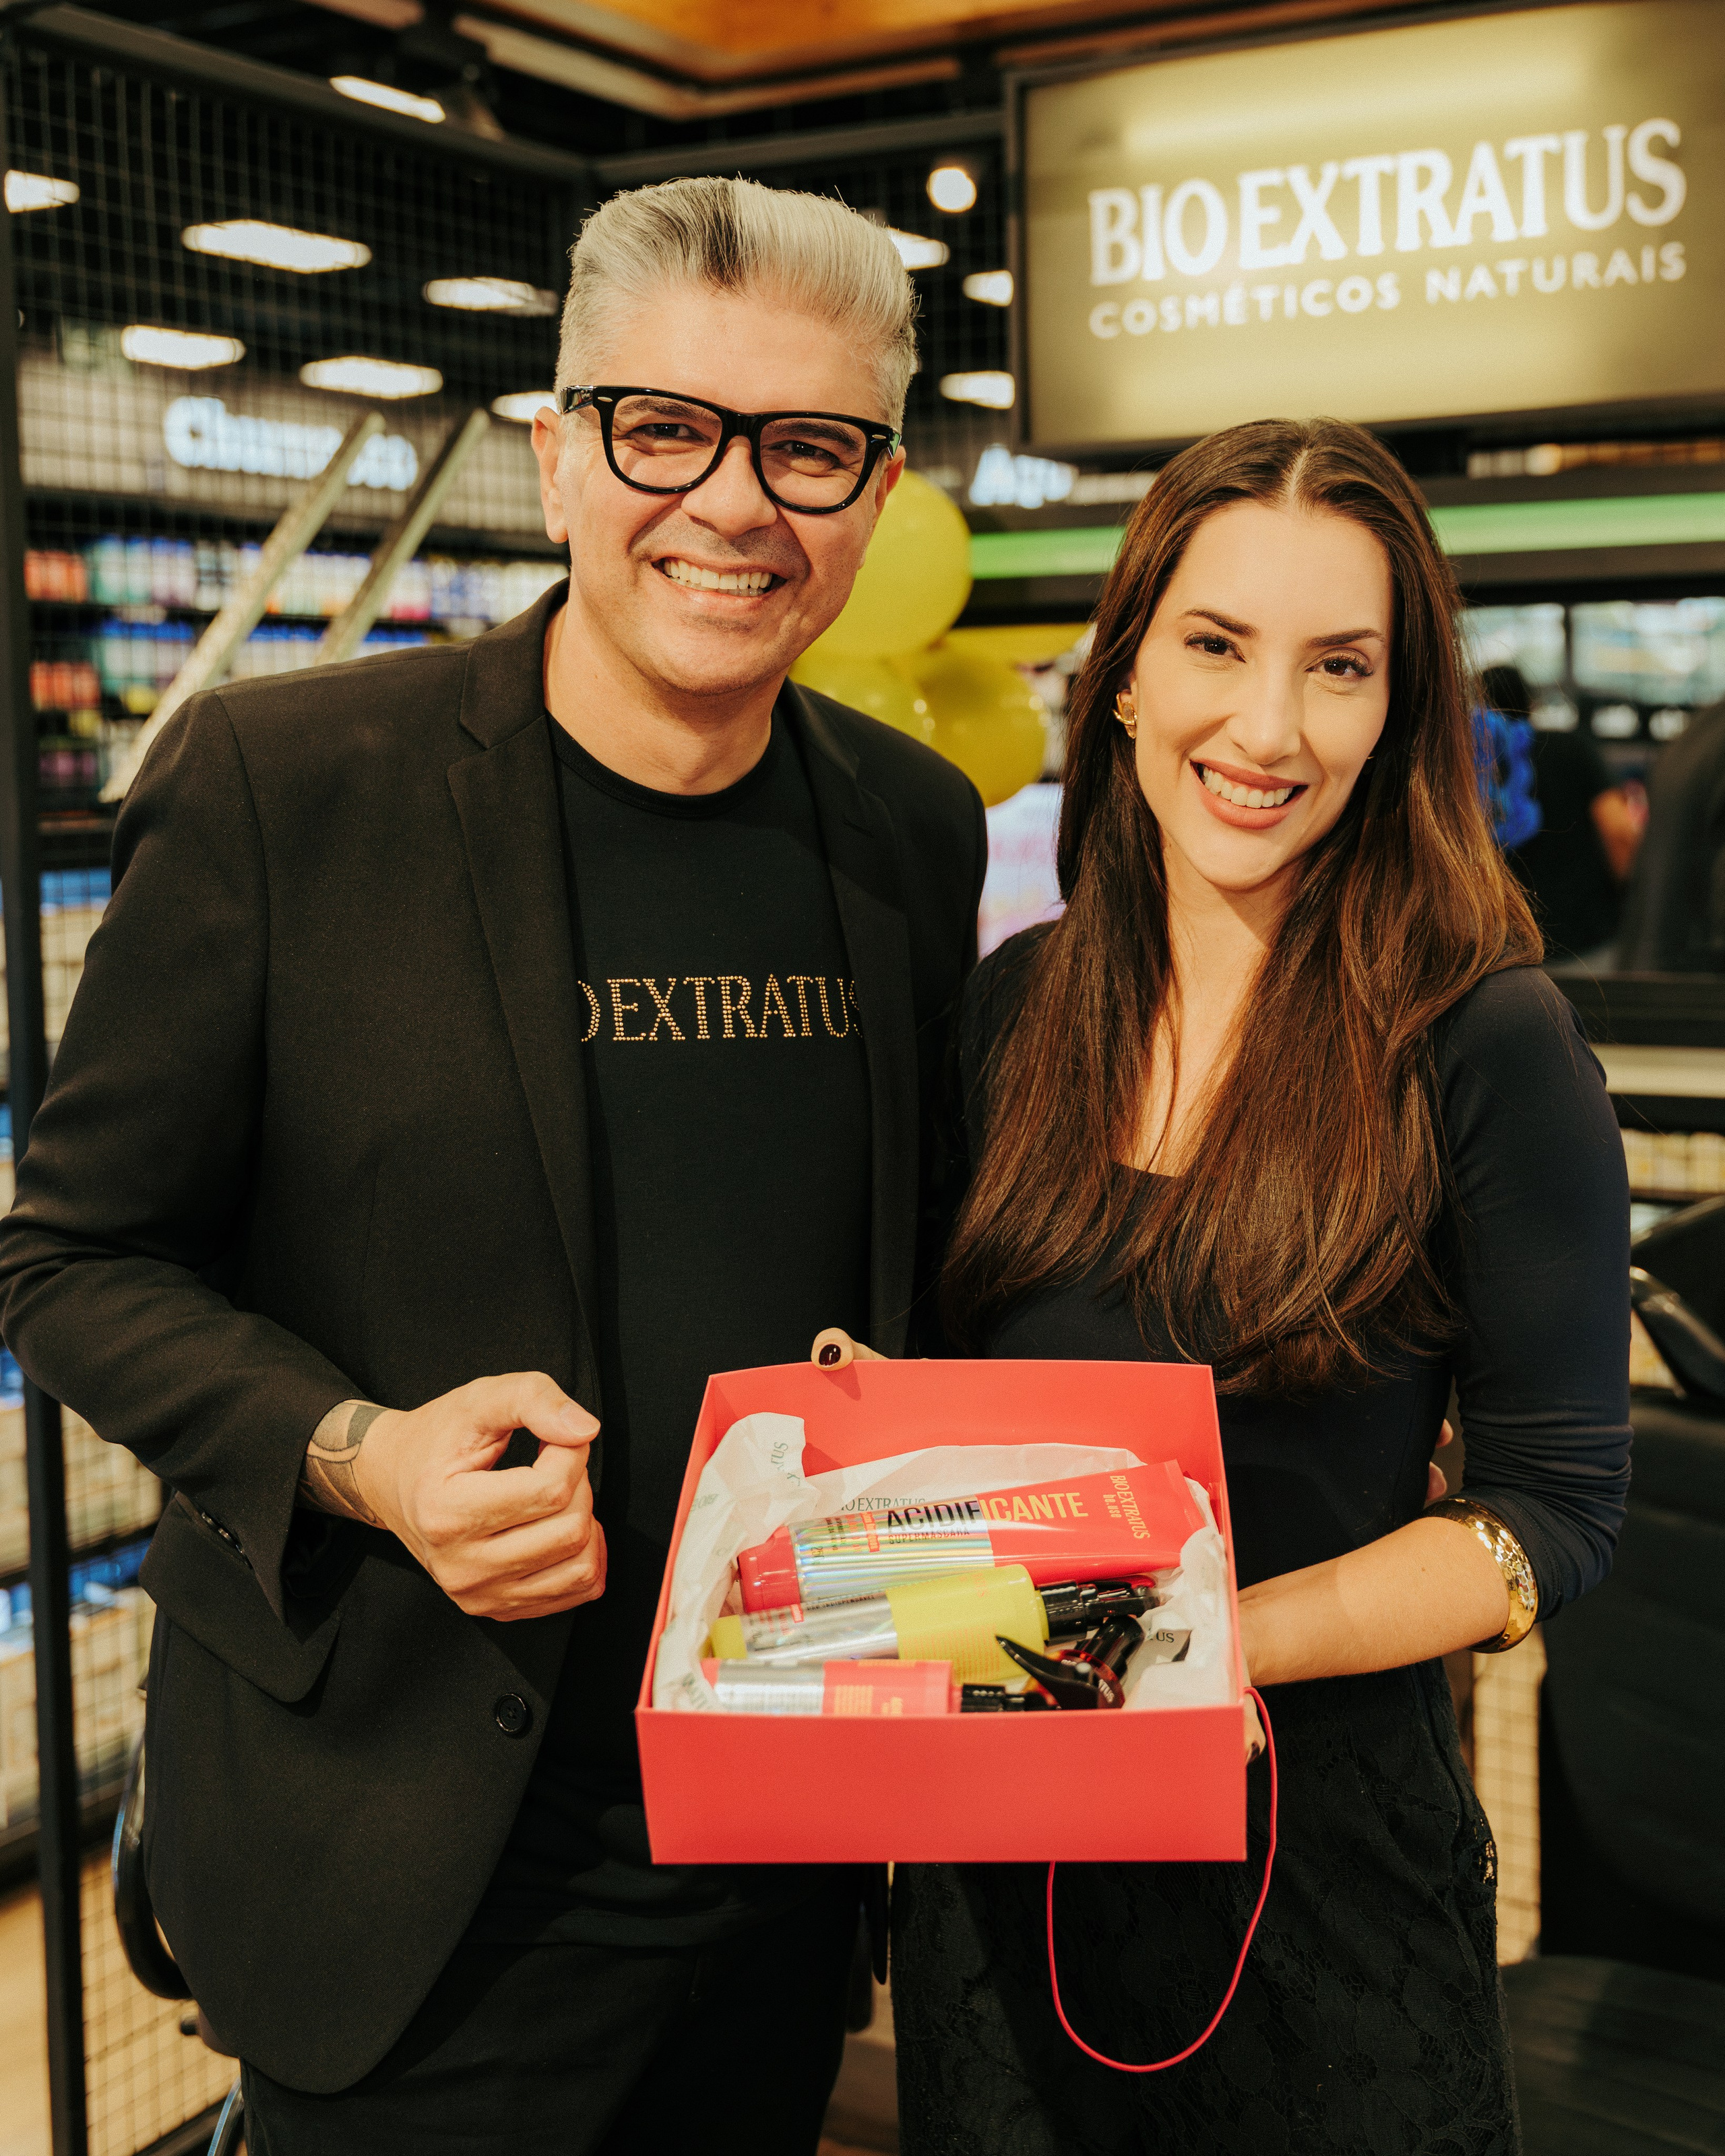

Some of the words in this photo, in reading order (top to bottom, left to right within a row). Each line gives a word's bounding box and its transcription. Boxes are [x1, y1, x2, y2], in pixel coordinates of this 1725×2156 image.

[1238, 117, 1687, 270] EXTRATUS
[1088, 272, 1401, 339] COSMÉTICOS
[1425, 241, 1687, 305] NATURAIS
[887, 1492, 1089, 1533] ACIDIFICANTE
[1102, 1494, 1123, 1519] be.use
